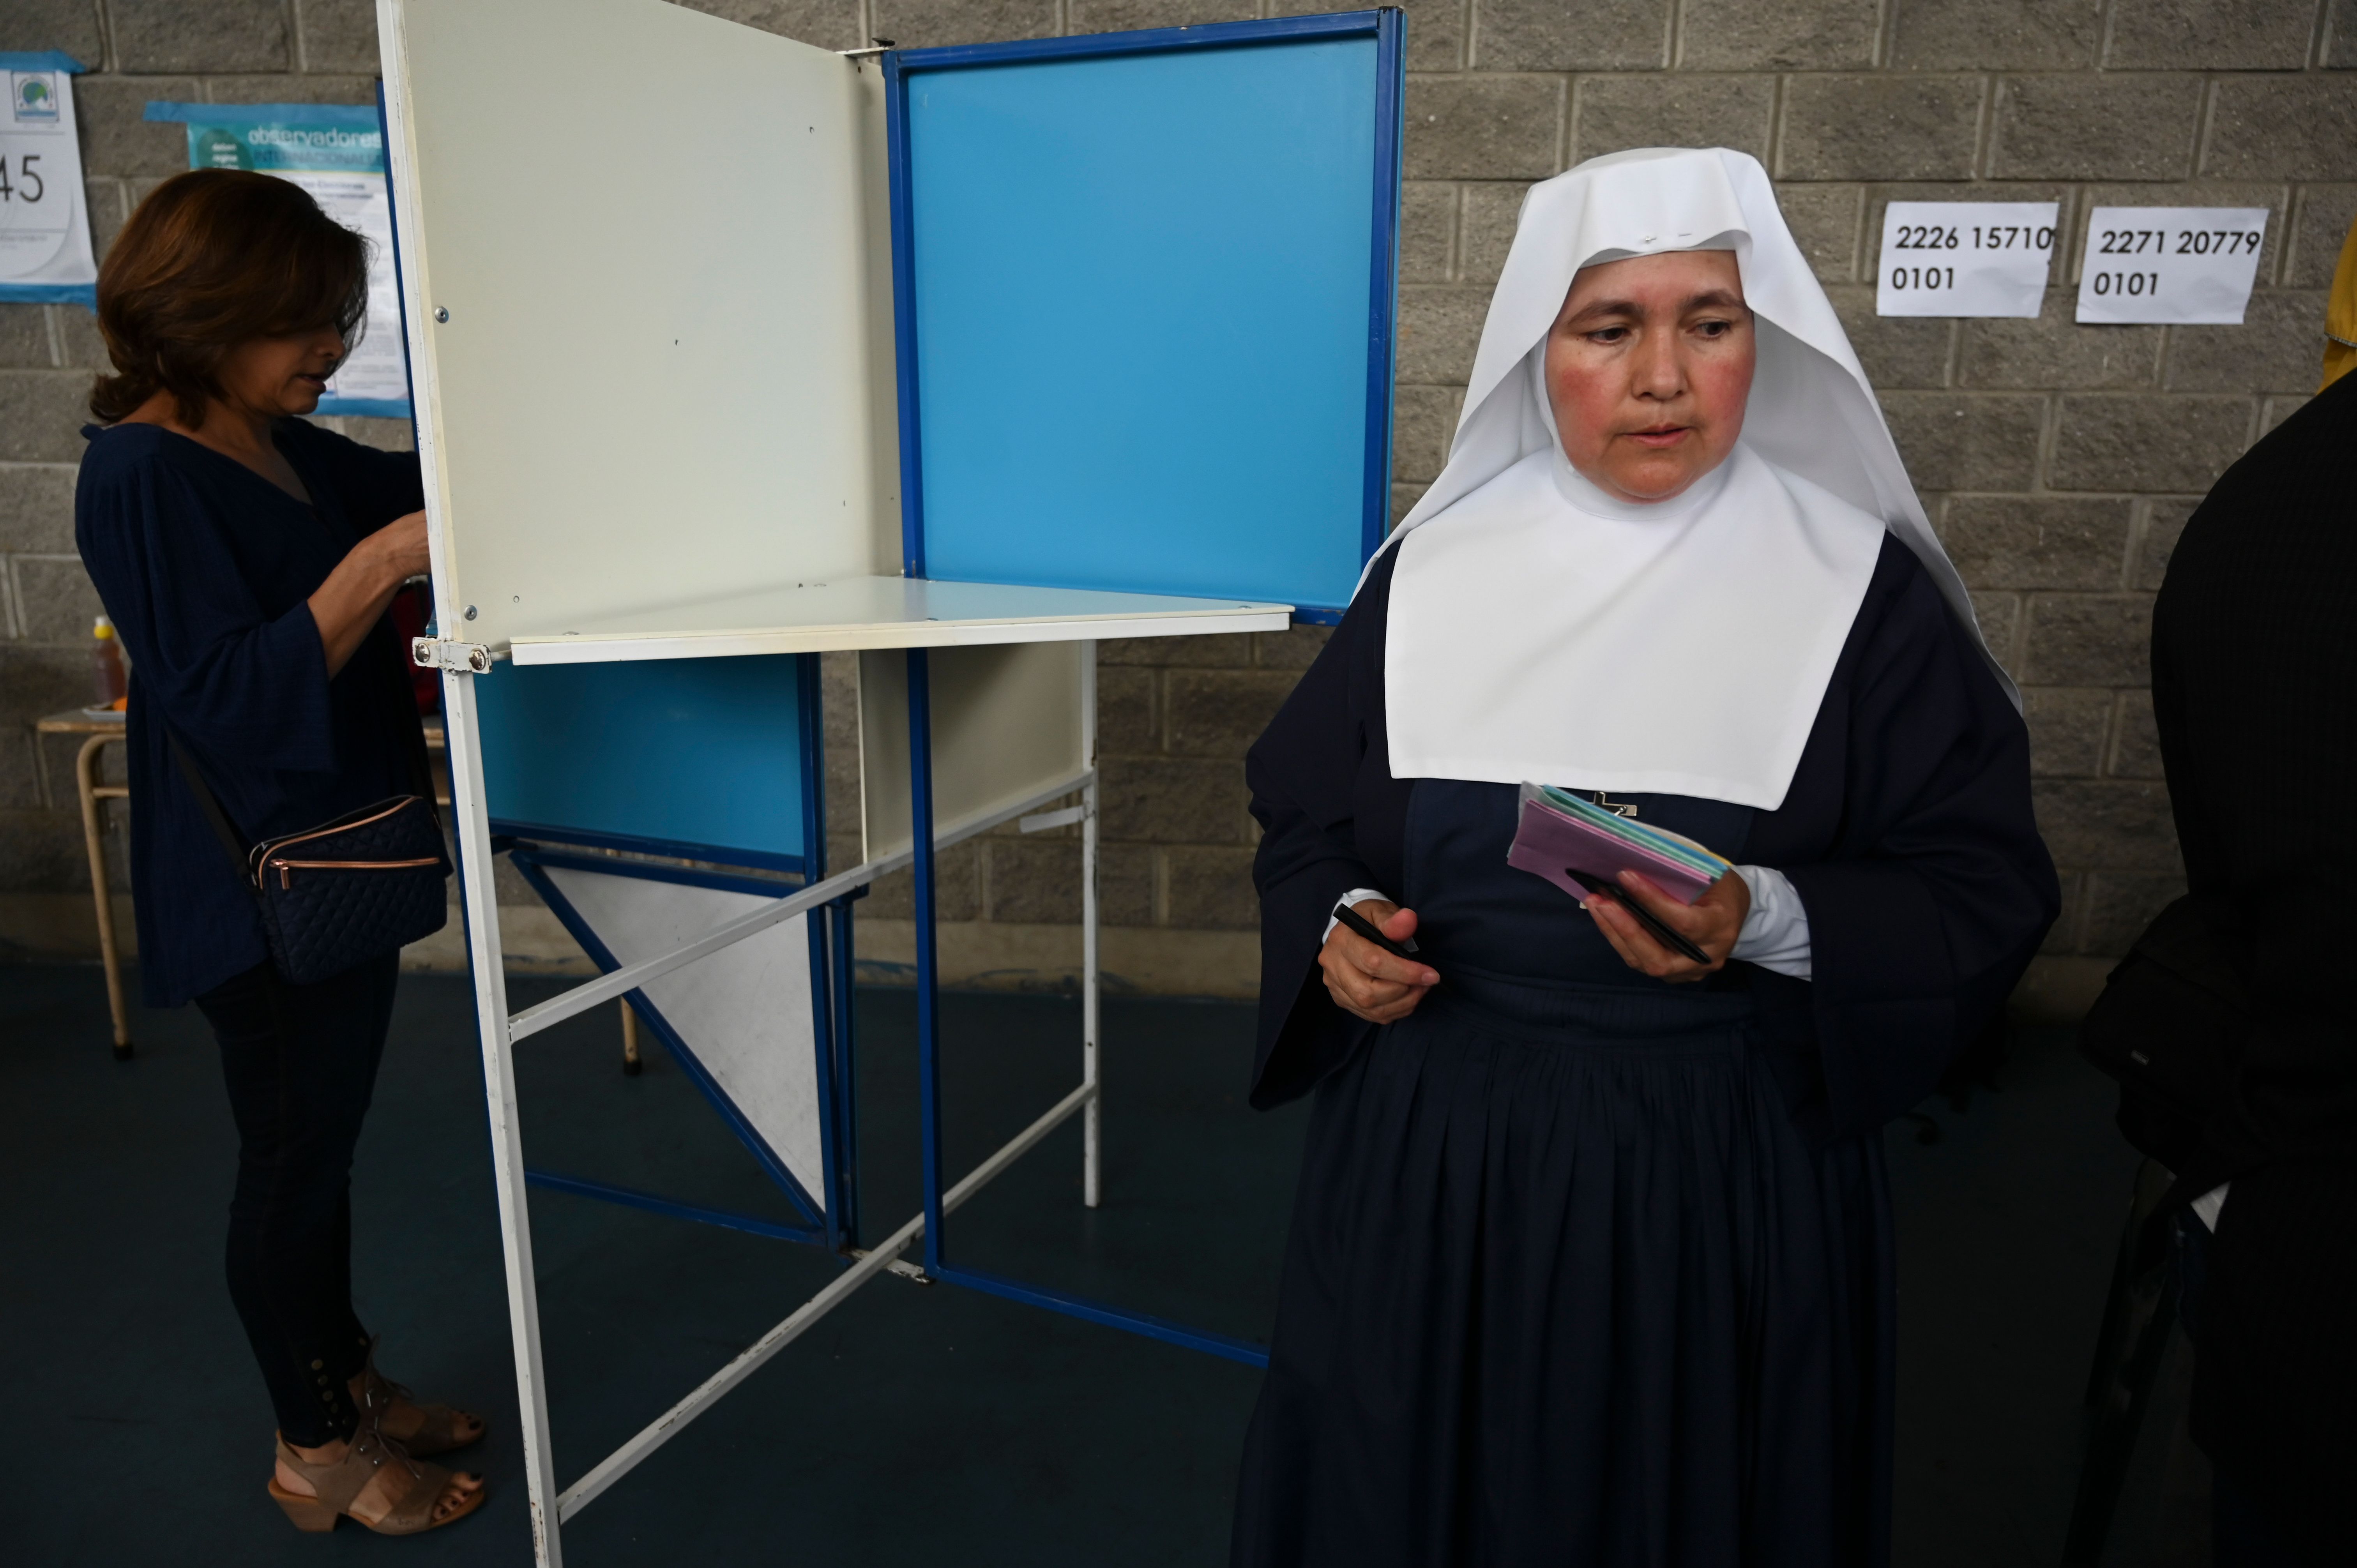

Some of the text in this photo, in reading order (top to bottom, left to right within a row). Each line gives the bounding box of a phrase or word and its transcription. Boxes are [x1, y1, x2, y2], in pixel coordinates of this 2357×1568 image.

[248, 126, 382, 148] observadores
[1896, 226, 2052, 249] 2226 15710
[2100, 231, 2260, 254] 2271 20779
[1892, 268, 1953, 290] 0101
[2094, 272, 2157, 295] 0101
